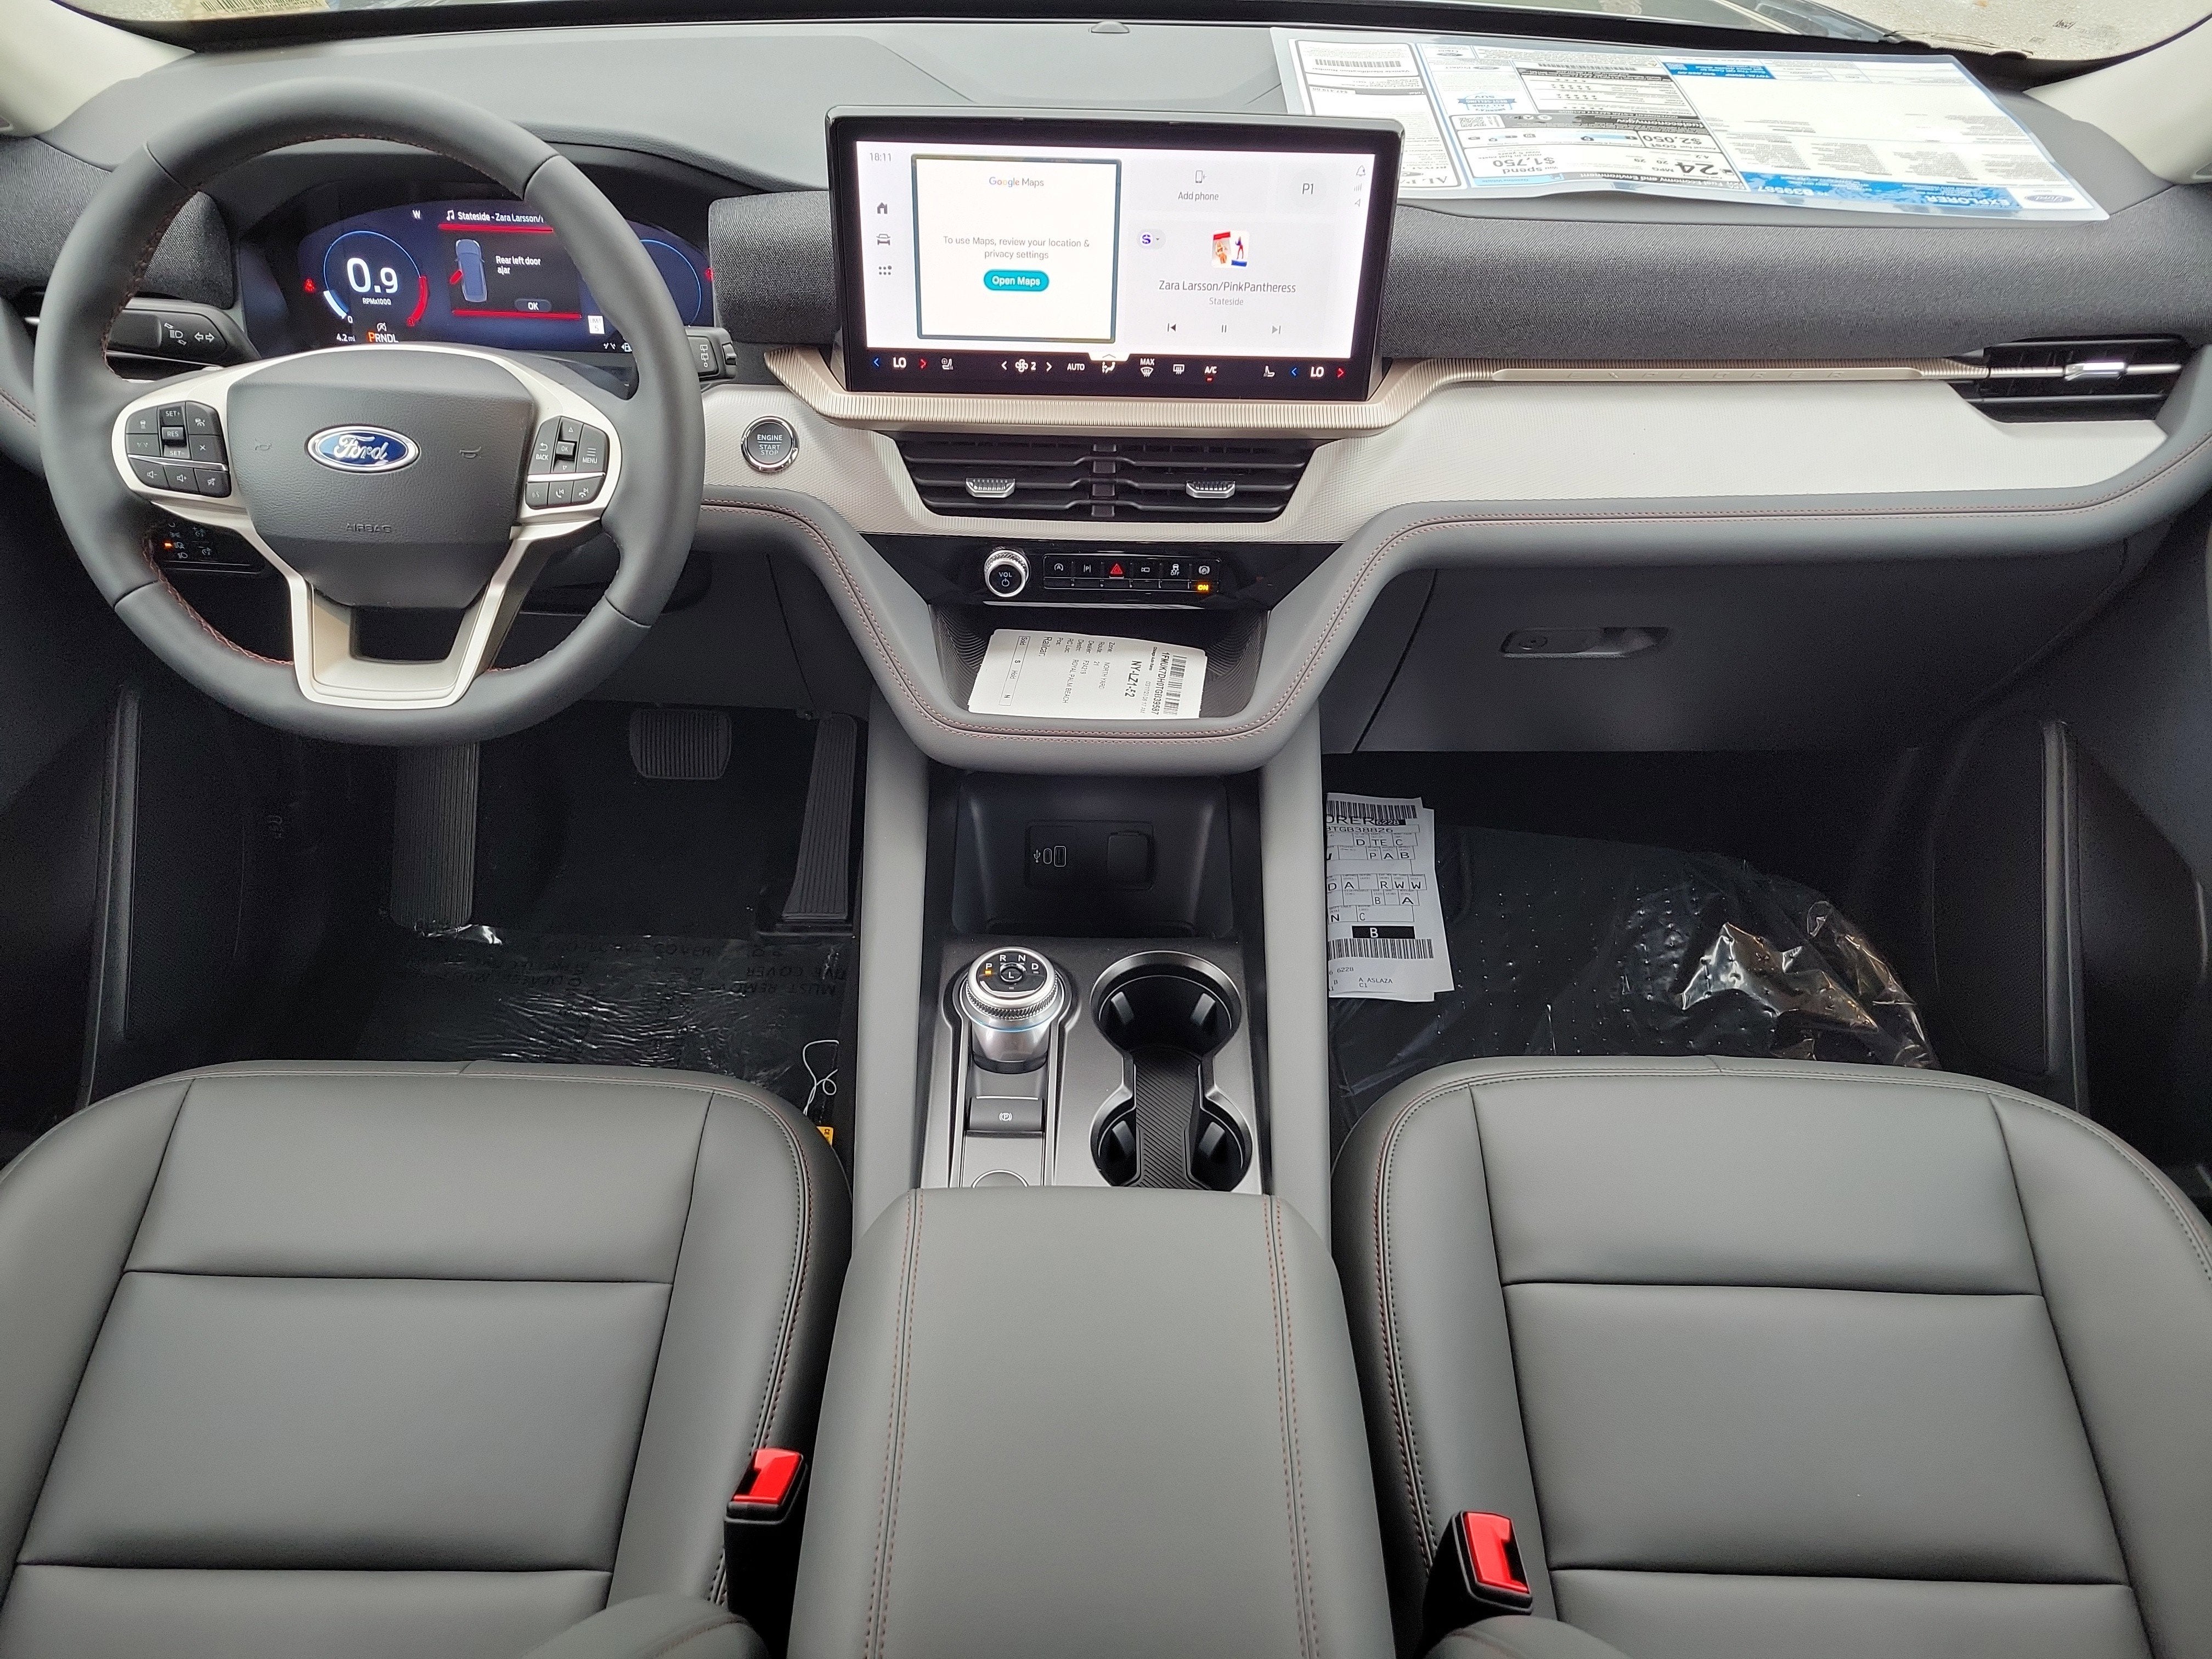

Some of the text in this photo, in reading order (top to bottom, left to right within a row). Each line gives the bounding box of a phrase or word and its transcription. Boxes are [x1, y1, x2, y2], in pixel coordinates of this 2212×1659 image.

[1643, 136, 1701, 145] $2,050
[869, 153, 891, 162] 18:11
[1493, 157, 1555, 167] $1,750
[1675, 162, 1718, 175] 24
[989, 177, 1044, 188] Google Maps
[1302, 183, 1313, 194] P1
[1178, 191, 1219, 201] Add phone
[1923, 195, 2011, 206] EXPLORER
[412, 210, 420, 219] W
[458, 212, 489, 221] Stateside
[495, 213, 510, 222] Zara
[973, 238, 996, 246] Maps,
[999, 238, 1026, 246] review
[1048, 239, 1081, 247] location
[985, 250, 1049, 261] privacy settings
[495, 256, 541, 266] Rear left door
[347, 258, 399, 293] 0.9
[497, 266, 511, 275] ajar
[992, 275, 1041, 288] Open Maps
[1159, 280, 1296, 293] Zara Larsson/PinkPantheress
[1209, 297, 1244, 306] Stateside
[347, 315, 353, 324] 0
[336, 334, 348, 342] 4.2
[368, 332, 399, 343] PRNDL
[893, 357, 906, 368] LO
[1031, 362, 1036, 370] 2
[1311, 367, 1324, 377] LO
[1066, 638, 1074, 646] RC
[1063, 659, 1079, 703] ROYAL PALM BEACH
[1098, 662, 1111, 690] NORTH YARD
[1328, 883, 1337, 891] D
[1330, 913, 1365, 922] N C
[1369, 927, 1379, 938] B
